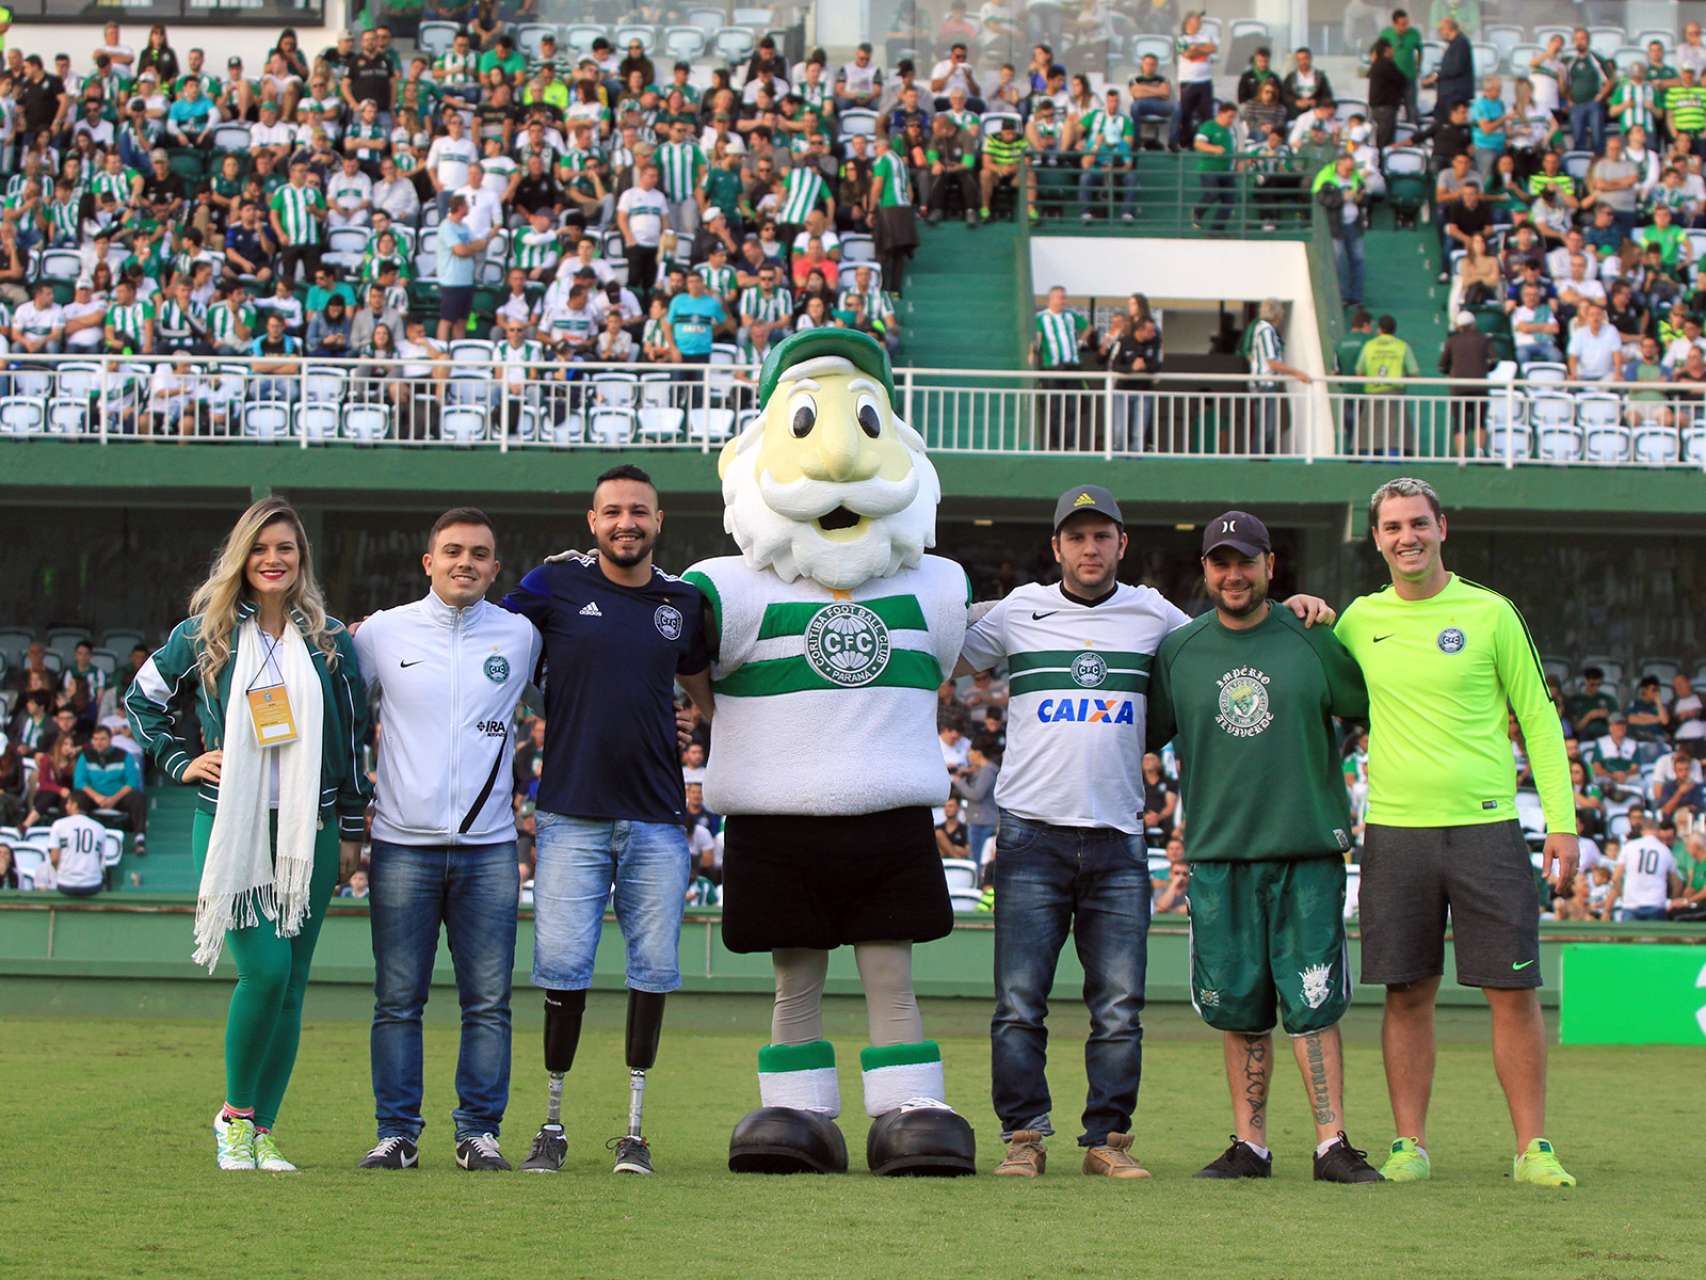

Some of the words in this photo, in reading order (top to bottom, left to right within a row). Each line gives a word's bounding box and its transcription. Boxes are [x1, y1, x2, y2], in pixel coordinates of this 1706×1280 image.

[808, 616, 828, 666] CORITIBA
[826, 605, 855, 617] FOOT
[858, 609, 882, 633] BALL
[877, 635, 888, 664] CLUB
[824, 632, 873, 653] CFC
[1037, 698, 1134, 725] CAIXA
[485, 720, 506, 732] IRA
[73, 826, 94, 854] 10
[1638, 848, 1660, 875] 10
